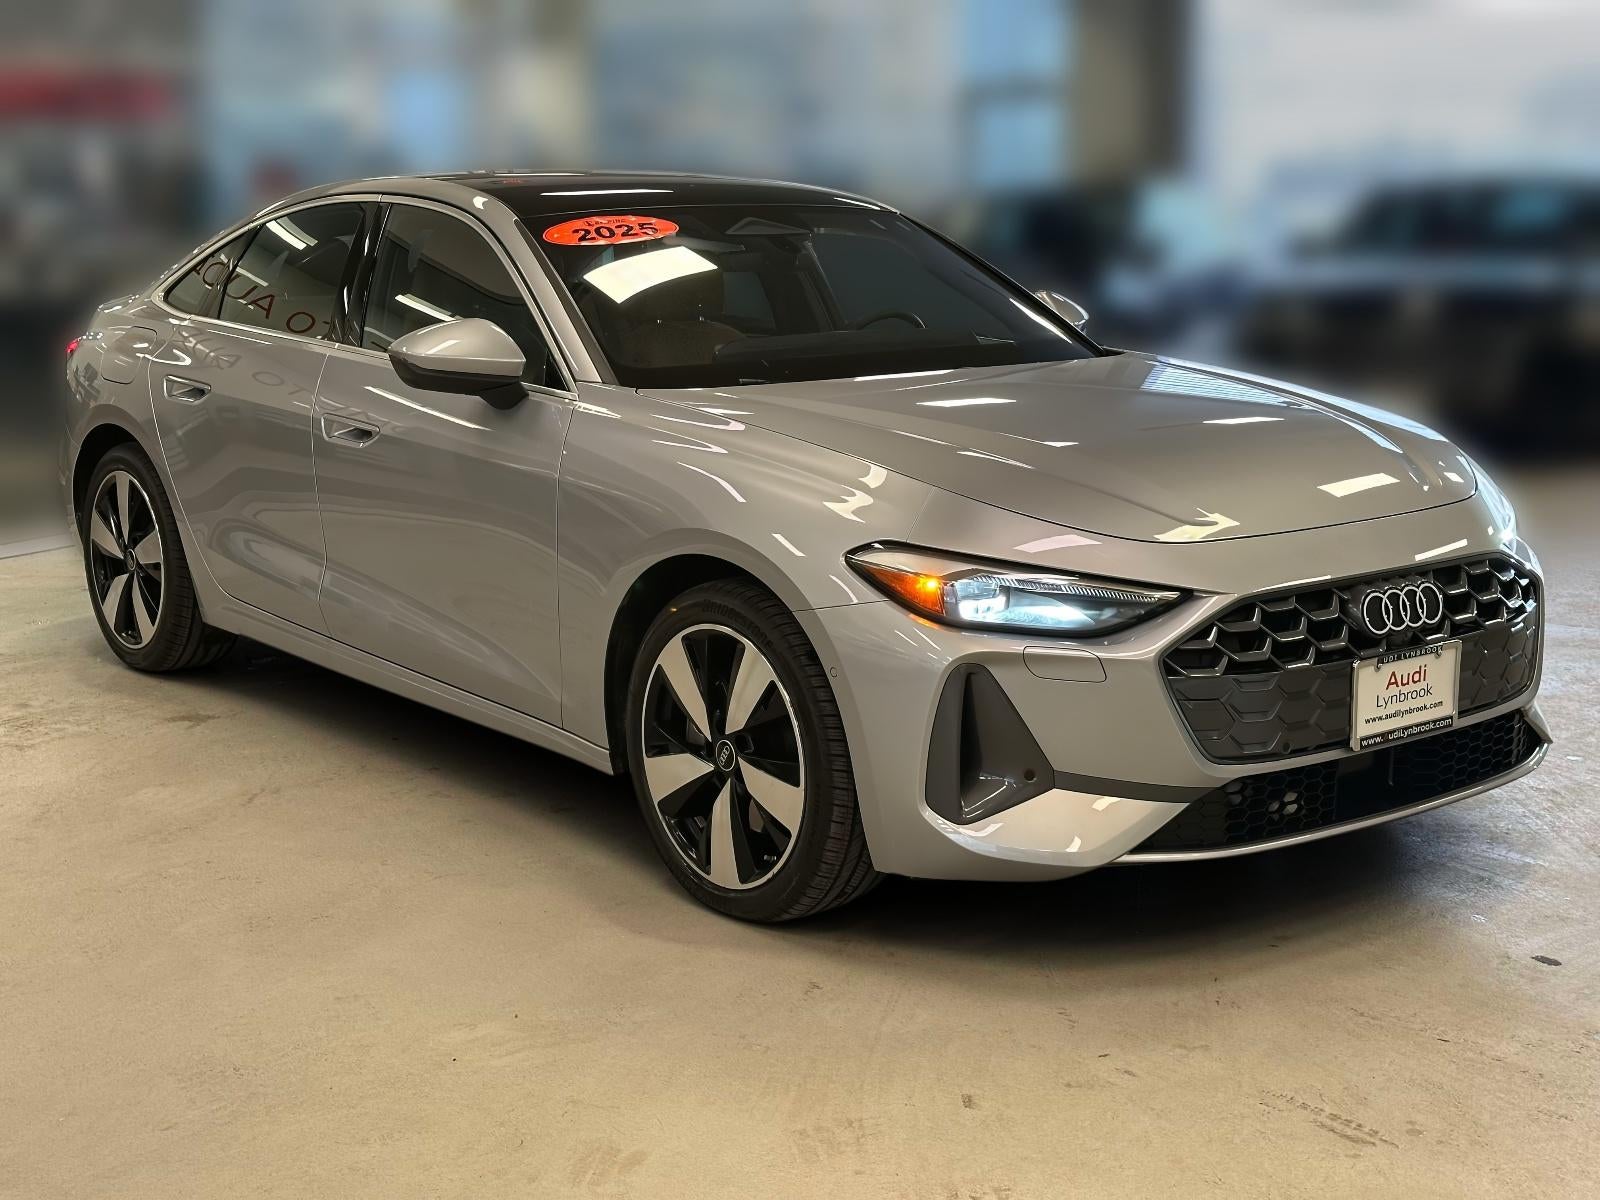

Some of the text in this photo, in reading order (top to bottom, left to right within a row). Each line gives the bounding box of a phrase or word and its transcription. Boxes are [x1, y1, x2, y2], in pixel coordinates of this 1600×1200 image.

[572, 222, 659, 242] 2025
[1379, 645, 1443, 664] UDI LYNBROOK
[1385, 664, 1427, 690] Audi
[1376, 683, 1433, 709] Lynbrook
[1364, 700, 1443, 724] www.audilynbrook.com
